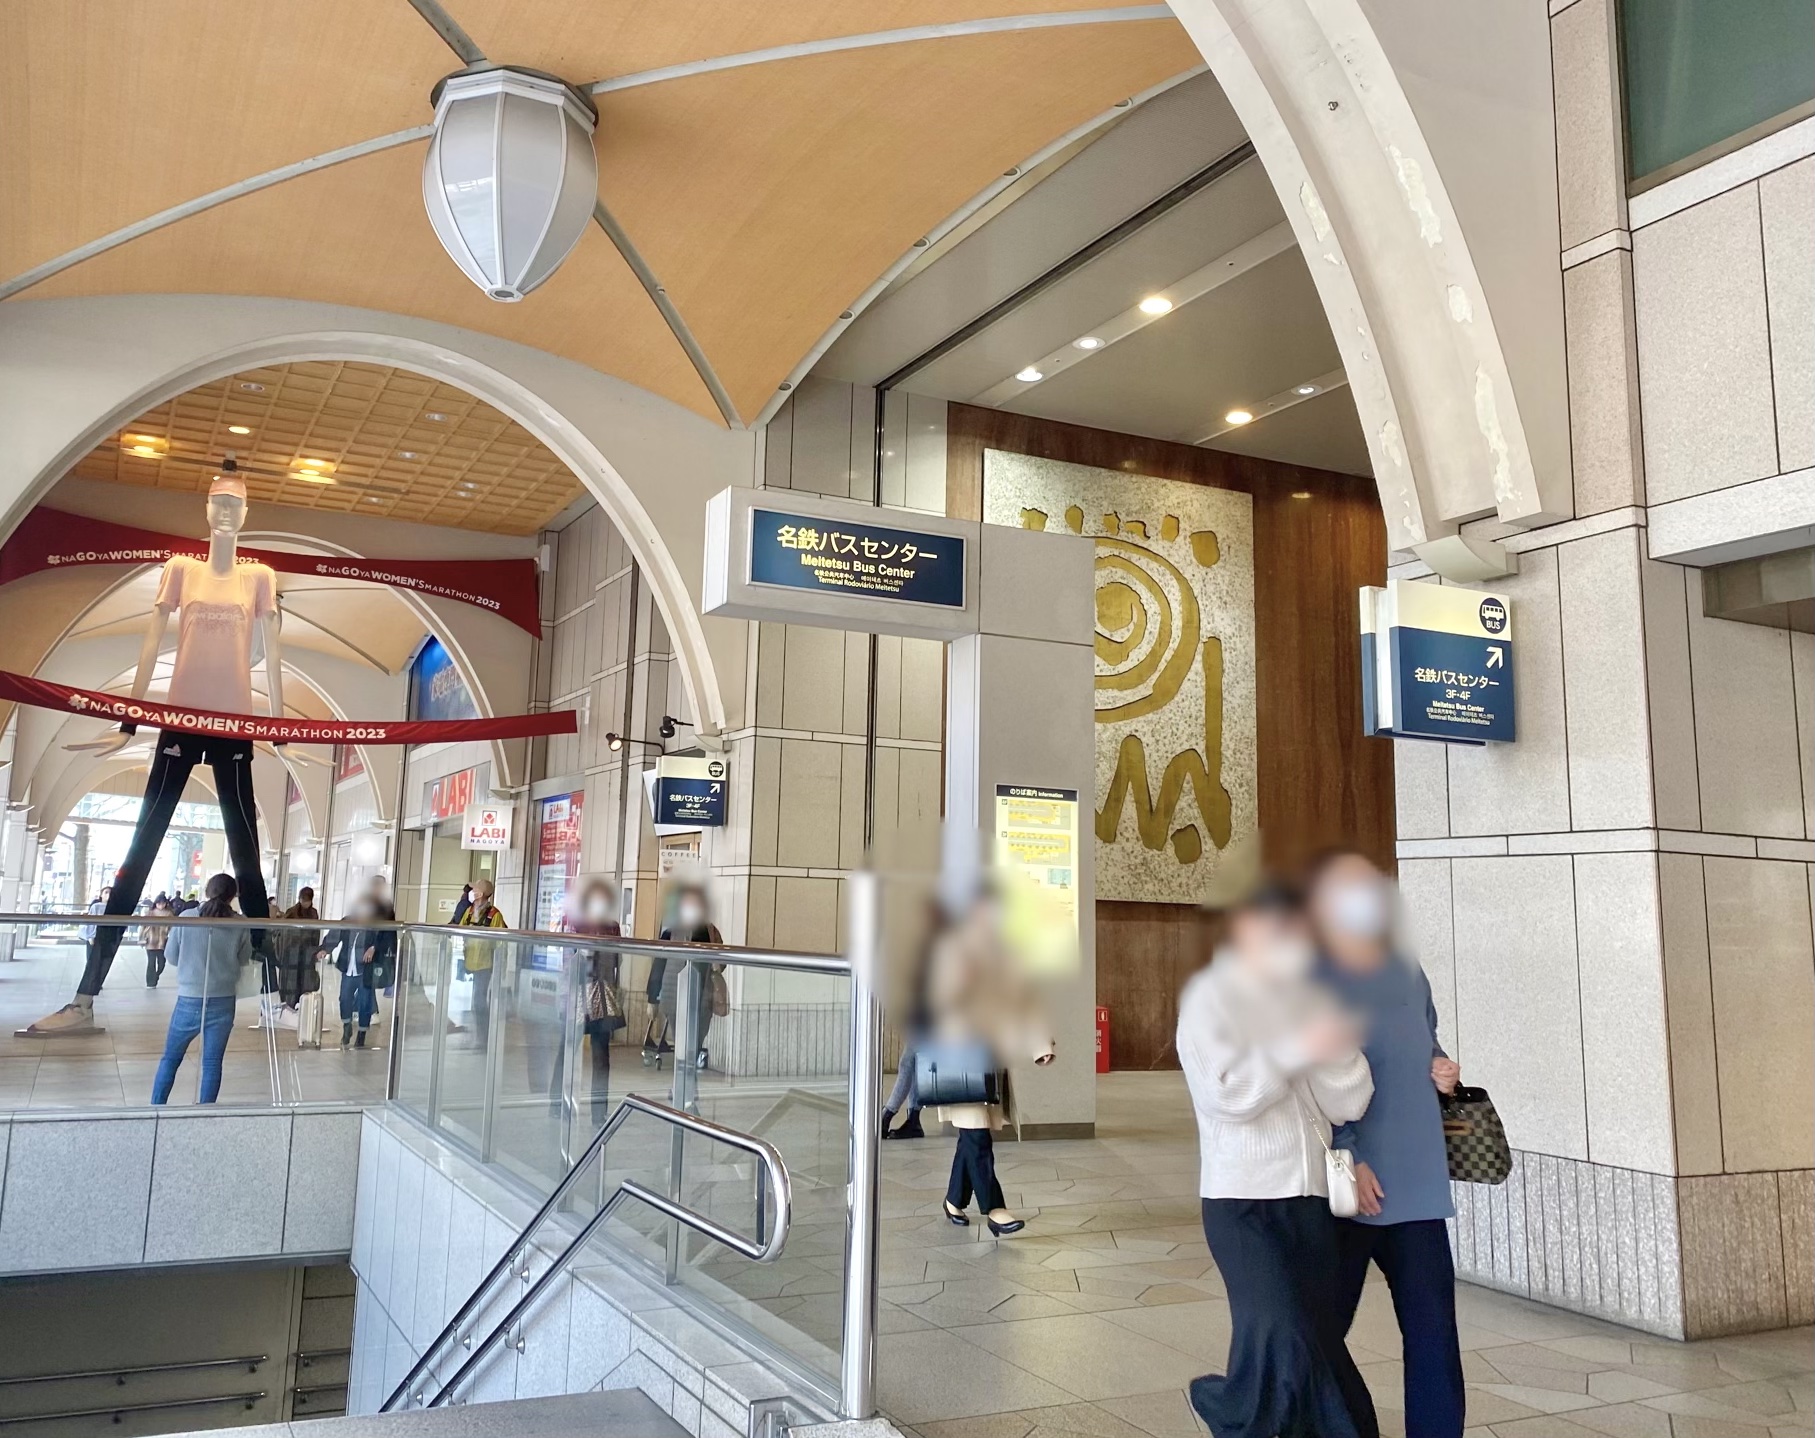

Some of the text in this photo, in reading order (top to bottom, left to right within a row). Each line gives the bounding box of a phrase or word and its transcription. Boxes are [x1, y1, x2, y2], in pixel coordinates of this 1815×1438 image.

[777, 524, 938, 563] 名鉄バスセンター
[62, 551, 110, 562] NAGOYA
[109, 550, 171, 560] WOMEN'S
[801, 553, 915, 579] Meitetsu Bus Center
[328, 566, 501, 610] NAGOYA WOMEN'S MARATHON 2023
[818, 576, 844, 586] Terminal
[875, 583, 900, 592] Meitetsu
[1486, 620, 1500, 630] BUS
[1414, 667, 1499, 689] 名鉄バスセンター
[1467, 704, 1485, 712] Center
[90, 700, 386, 739] NAGOYA WOMEN'S MARATHON 2023
[669, 794, 718, 803] 名鉄バスセンター
[470, 827, 506, 839] LABI
